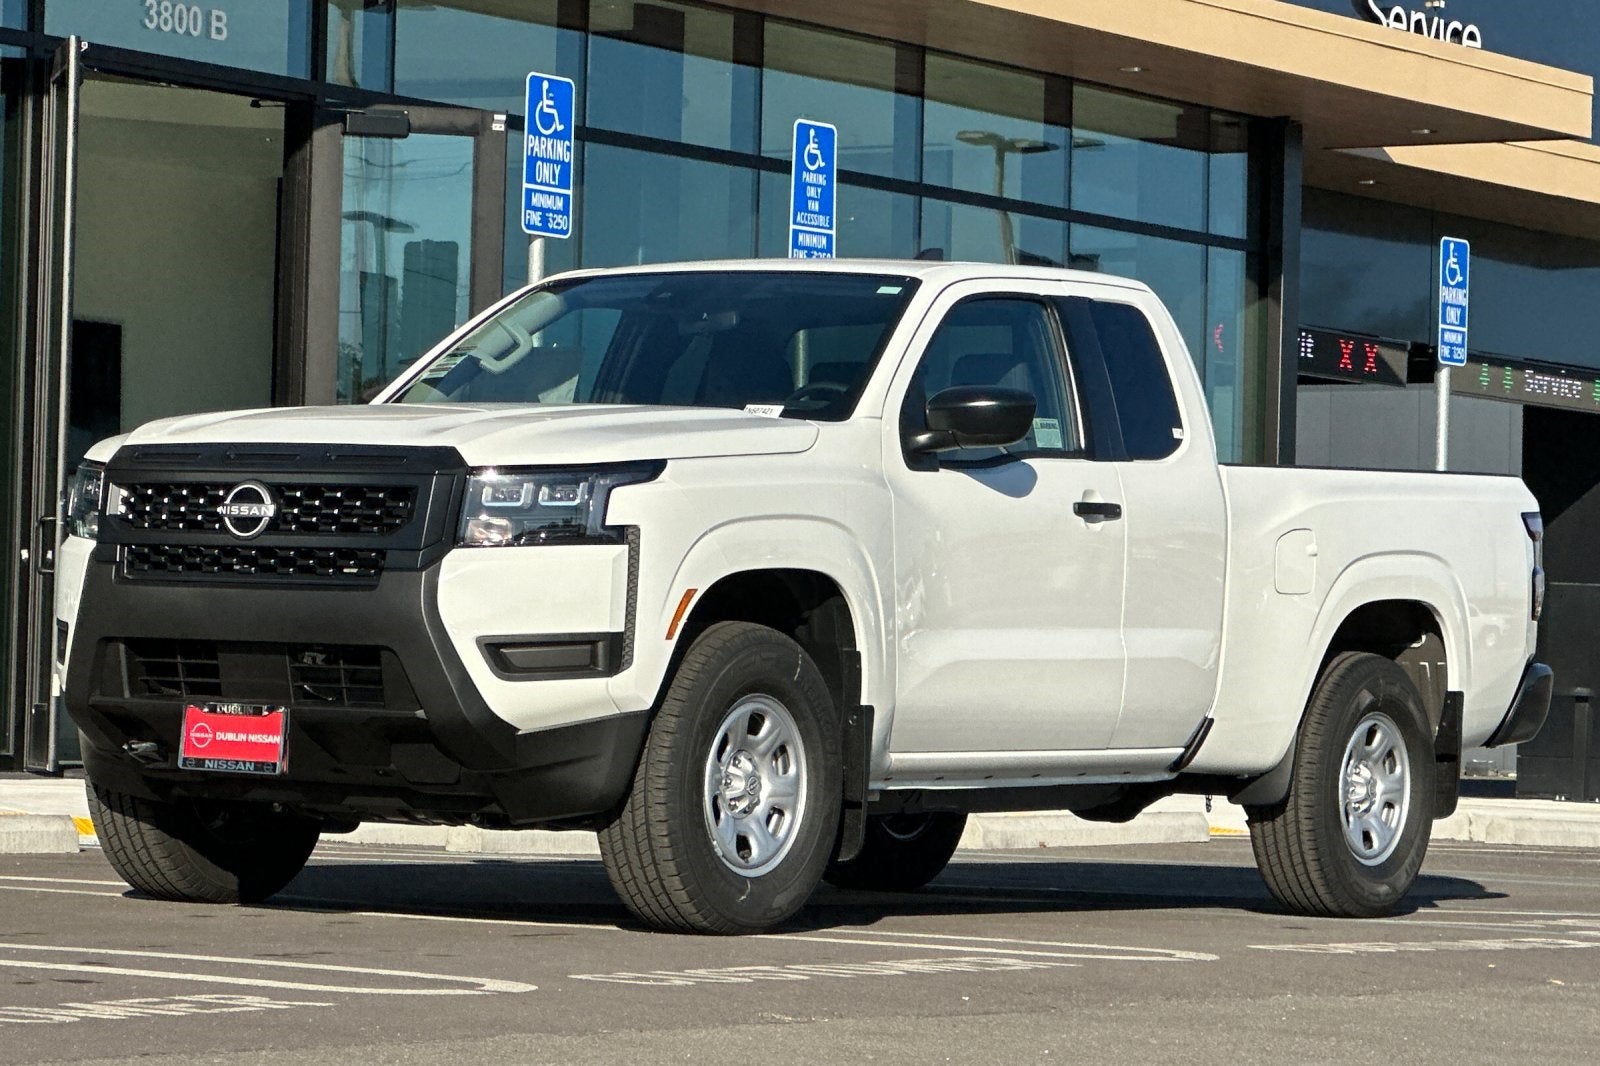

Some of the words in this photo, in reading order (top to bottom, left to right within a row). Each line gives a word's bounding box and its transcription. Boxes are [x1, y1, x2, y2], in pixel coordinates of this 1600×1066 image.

[144, 0, 202, 37] 3800
[210, 9, 228, 41] B
[527, 134, 571, 163] PARKING
[535, 161, 561, 186] ONLY
[802, 171, 827, 186] PARKING
[531, 191, 564, 211] MINIMUM
[806, 186, 822, 199] ONLY
[807, 199, 820, 212] VAN
[525, 211, 543, 227] FINE
[545, 213, 568, 231] $250
[796, 211, 830, 228] ACCESSIBLE
[798, 231, 827, 250] MINIMUM
[1441, 285, 1467, 306] PARKING
[1445, 305, 1461, 325] ONLY
[1524, 369, 1582, 399] Service
[219, 505, 274, 516] NISSAN
[217, 705, 253, 714] DUBLIN
[216, 731, 247, 741] DUBLIN
[248, 733, 280, 744] NISSAN
[204, 759, 255, 771] NISSAN
